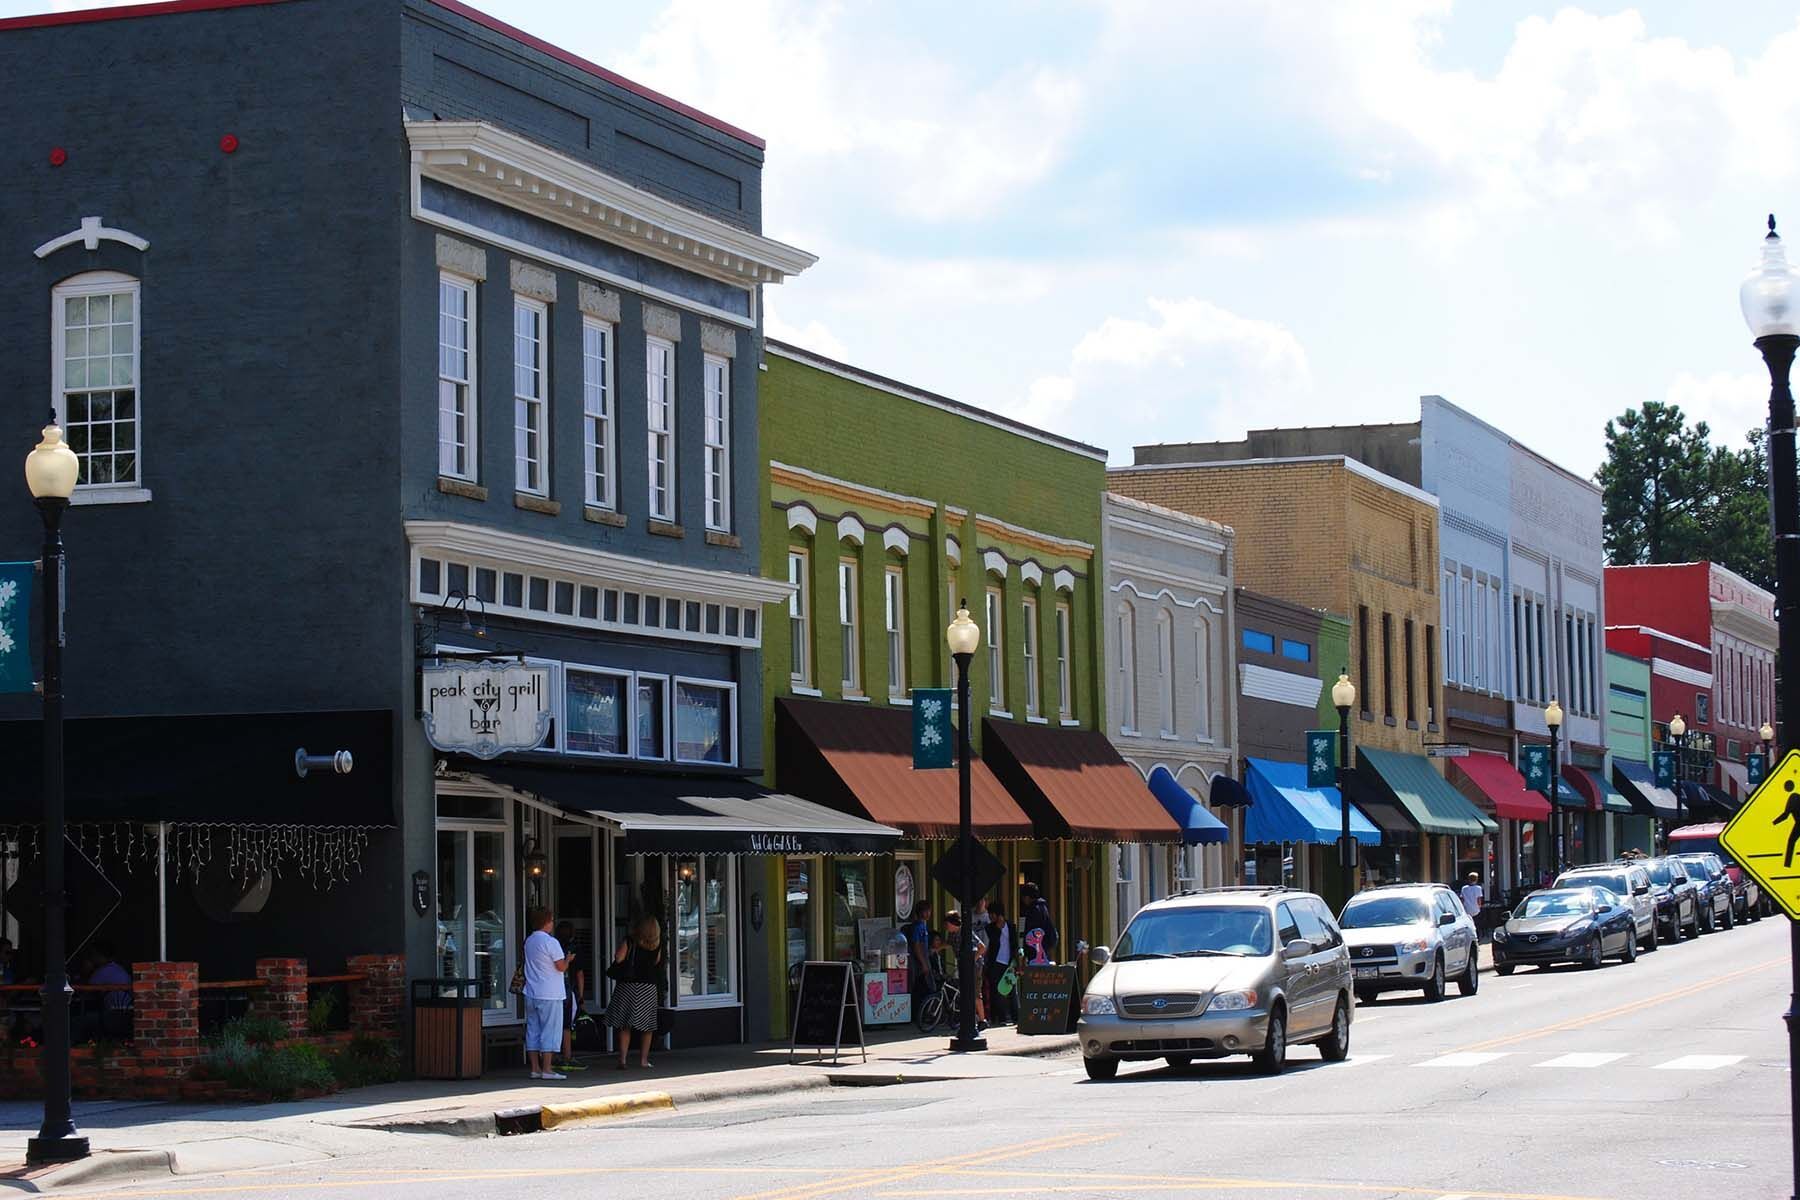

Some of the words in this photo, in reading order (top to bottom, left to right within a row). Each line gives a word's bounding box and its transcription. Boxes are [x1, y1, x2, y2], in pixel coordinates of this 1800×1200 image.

[430, 675, 468, 713] peak
[473, 678, 501, 712] city
[508, 674, 541, 712] grill
[470, 709, 501, 730] bar
[1026, 992, 1038, 1000] ICE
[1042, 992, 1068, 1000] CREAM
